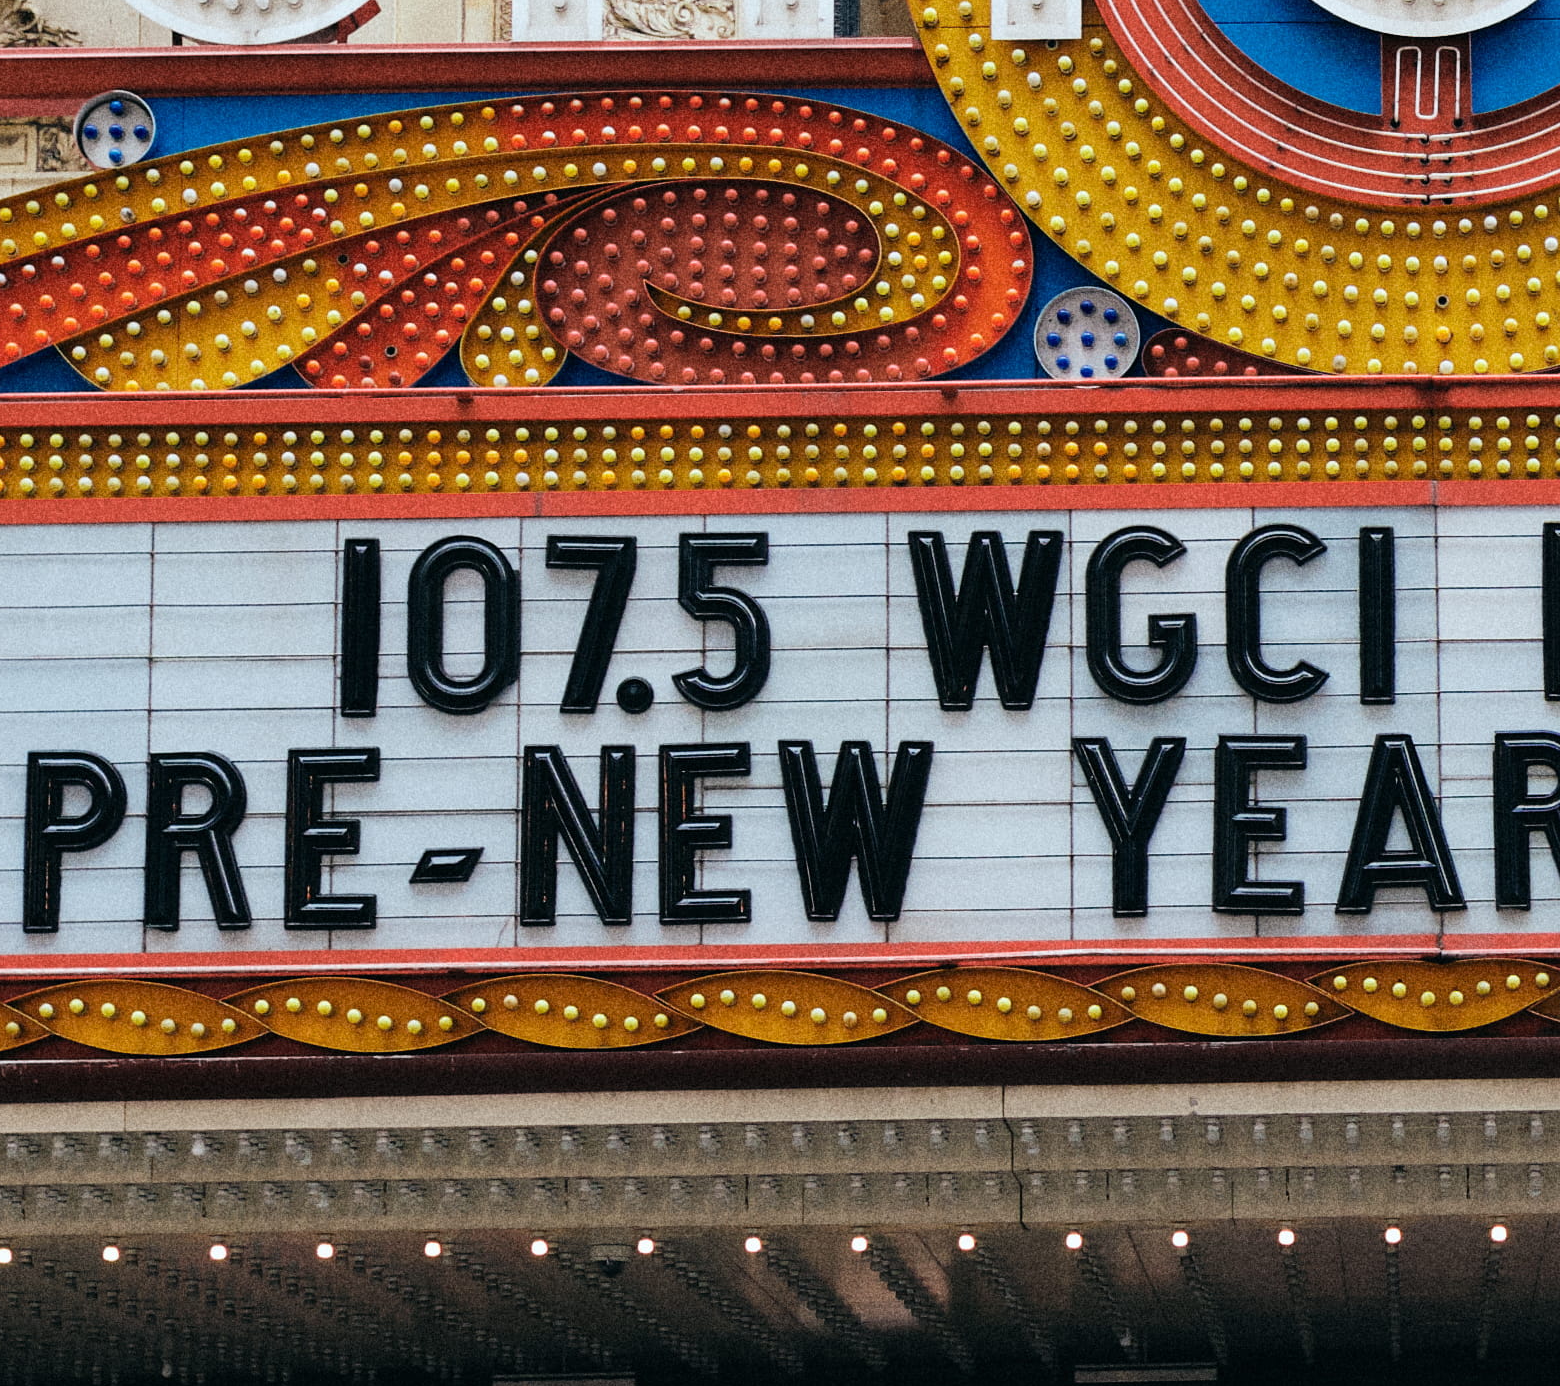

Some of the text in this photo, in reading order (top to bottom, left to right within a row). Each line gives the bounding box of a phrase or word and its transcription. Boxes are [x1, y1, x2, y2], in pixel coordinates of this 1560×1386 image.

[340, 530, 771, 719] 107.5
[907, 523, 1396, 712] WGCI
[22, 739, 934, 934] PRE-NEW
